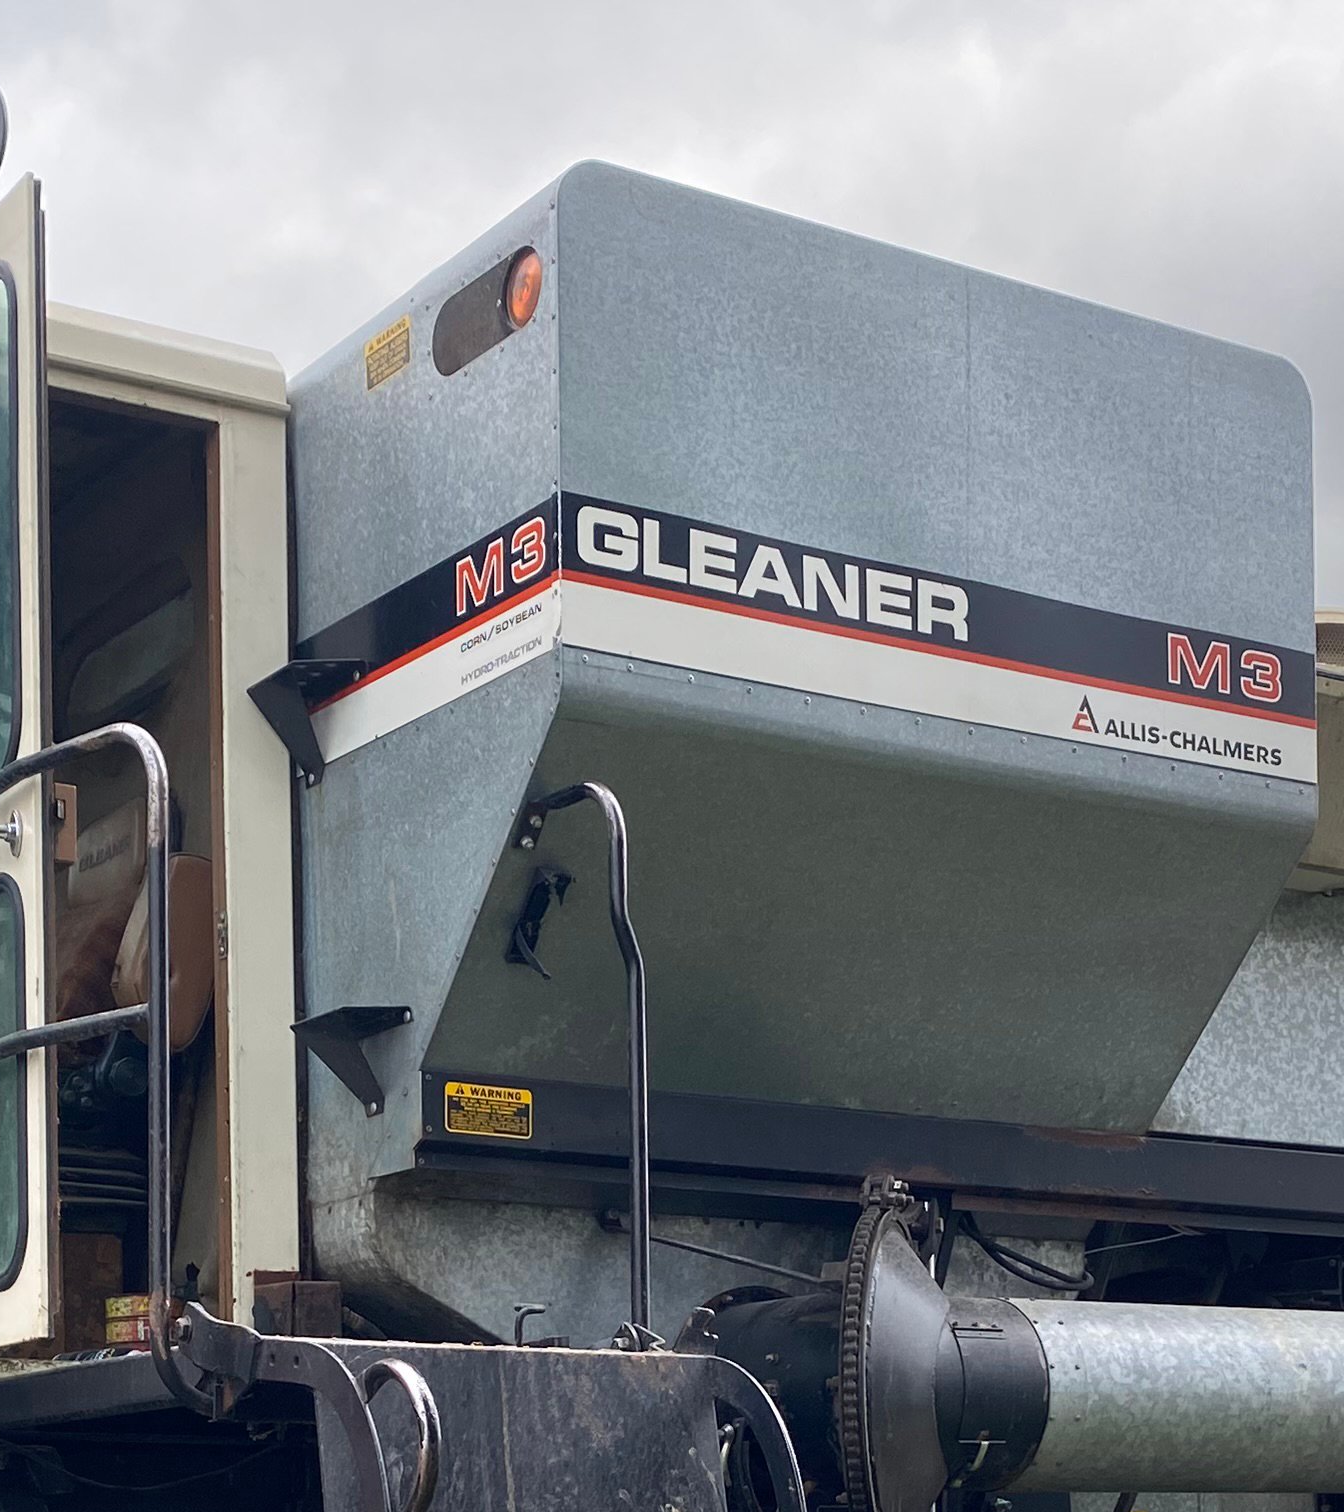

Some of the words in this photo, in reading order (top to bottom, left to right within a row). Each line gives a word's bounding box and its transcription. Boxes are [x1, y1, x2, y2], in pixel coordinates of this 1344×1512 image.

[455, 515, 546, 617] M3
[577, 505, 969, 642] GLEANER
[460, 601, 542, 653] CORN/SOYBEAN
[460, 635, 542, 686] HYDRO-TRACTION
[1166, 632, 1282, 703] M3
[1104, 717, 1282, 767] ALLIS-CHALMERS
[470, 1086, 522, 1101] WARNING
